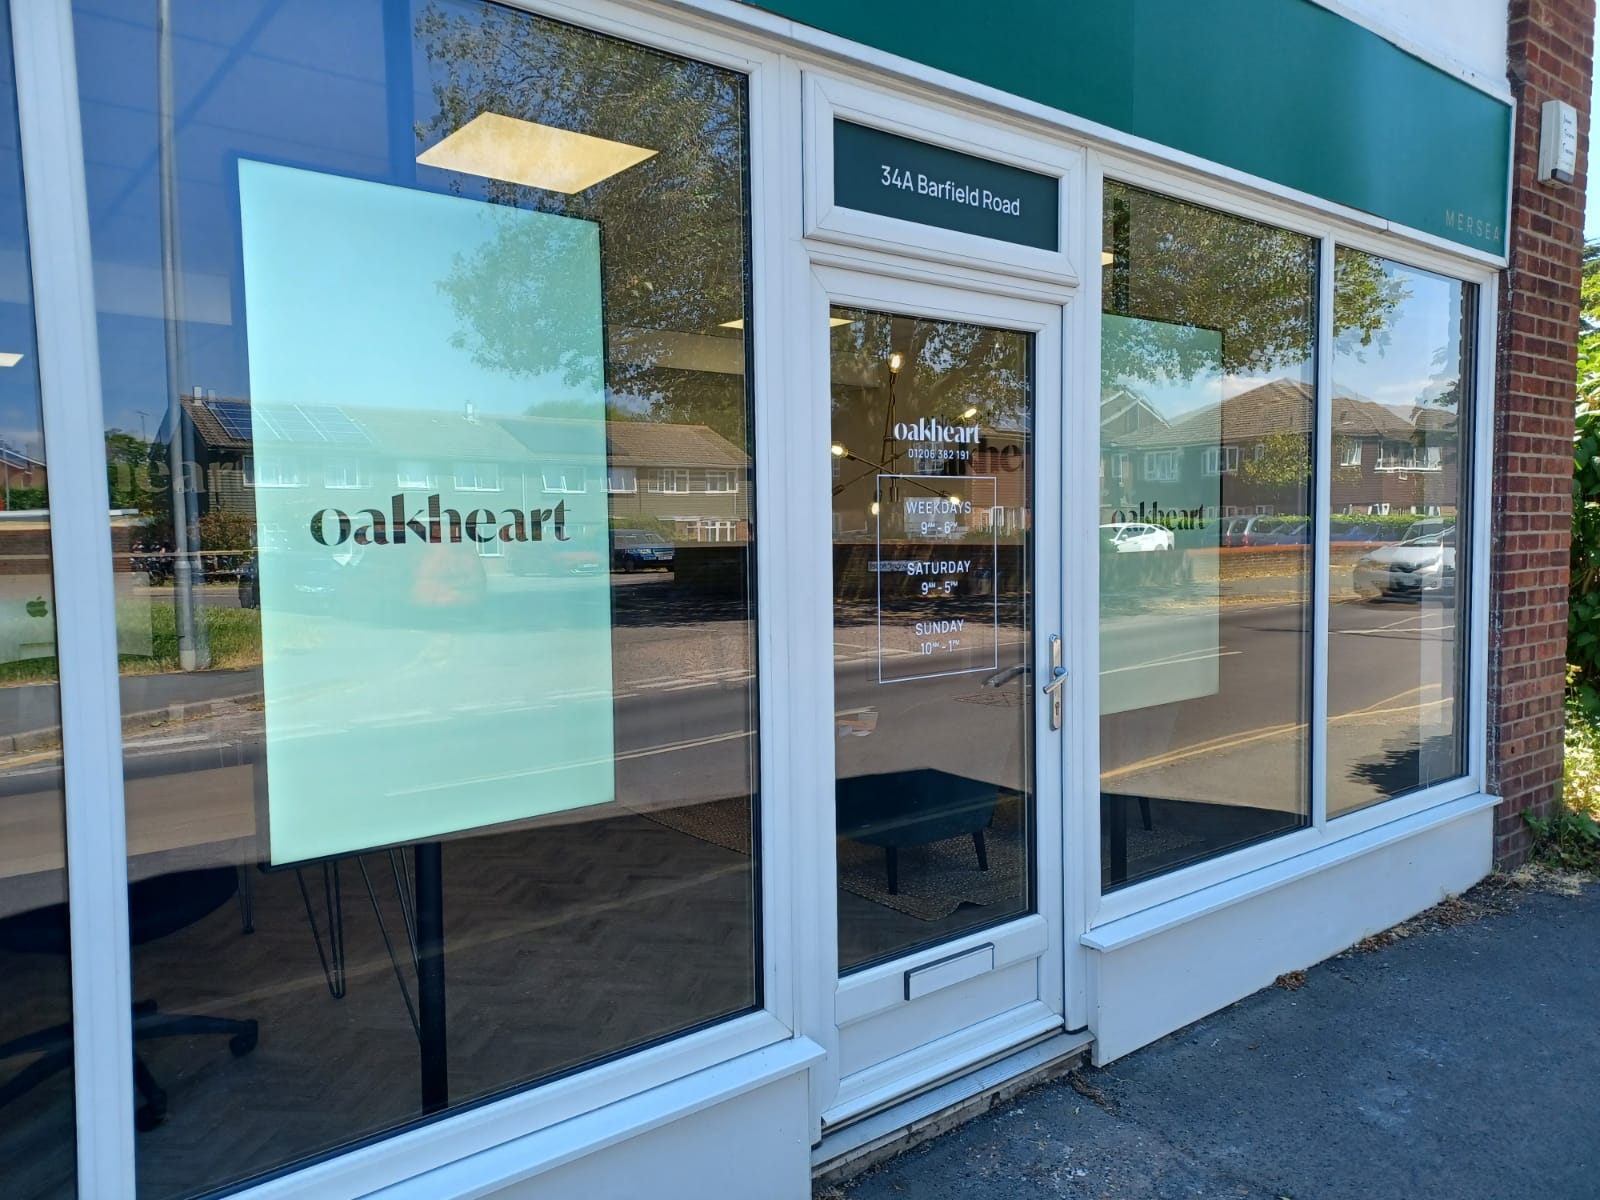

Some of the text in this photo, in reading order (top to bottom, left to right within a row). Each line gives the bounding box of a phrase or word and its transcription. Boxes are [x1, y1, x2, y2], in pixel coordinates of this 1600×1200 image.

[881, 164, 1020, 216] 34A Barfield Road
[1445, 209, 1500, 241] MERSEA
[894, 417, 981, 444] oakheart
[908, 448, 969, 460] 01206 382 191
[310, 493, 572, 546] oakheart
[905, 500, 972, 514] WEEKDAYS
[1111, 501, 1205, 533] oakheart
[907, 560, 971, 576] SATURDAY
[915, 619, 964, 636] SUNDAY
